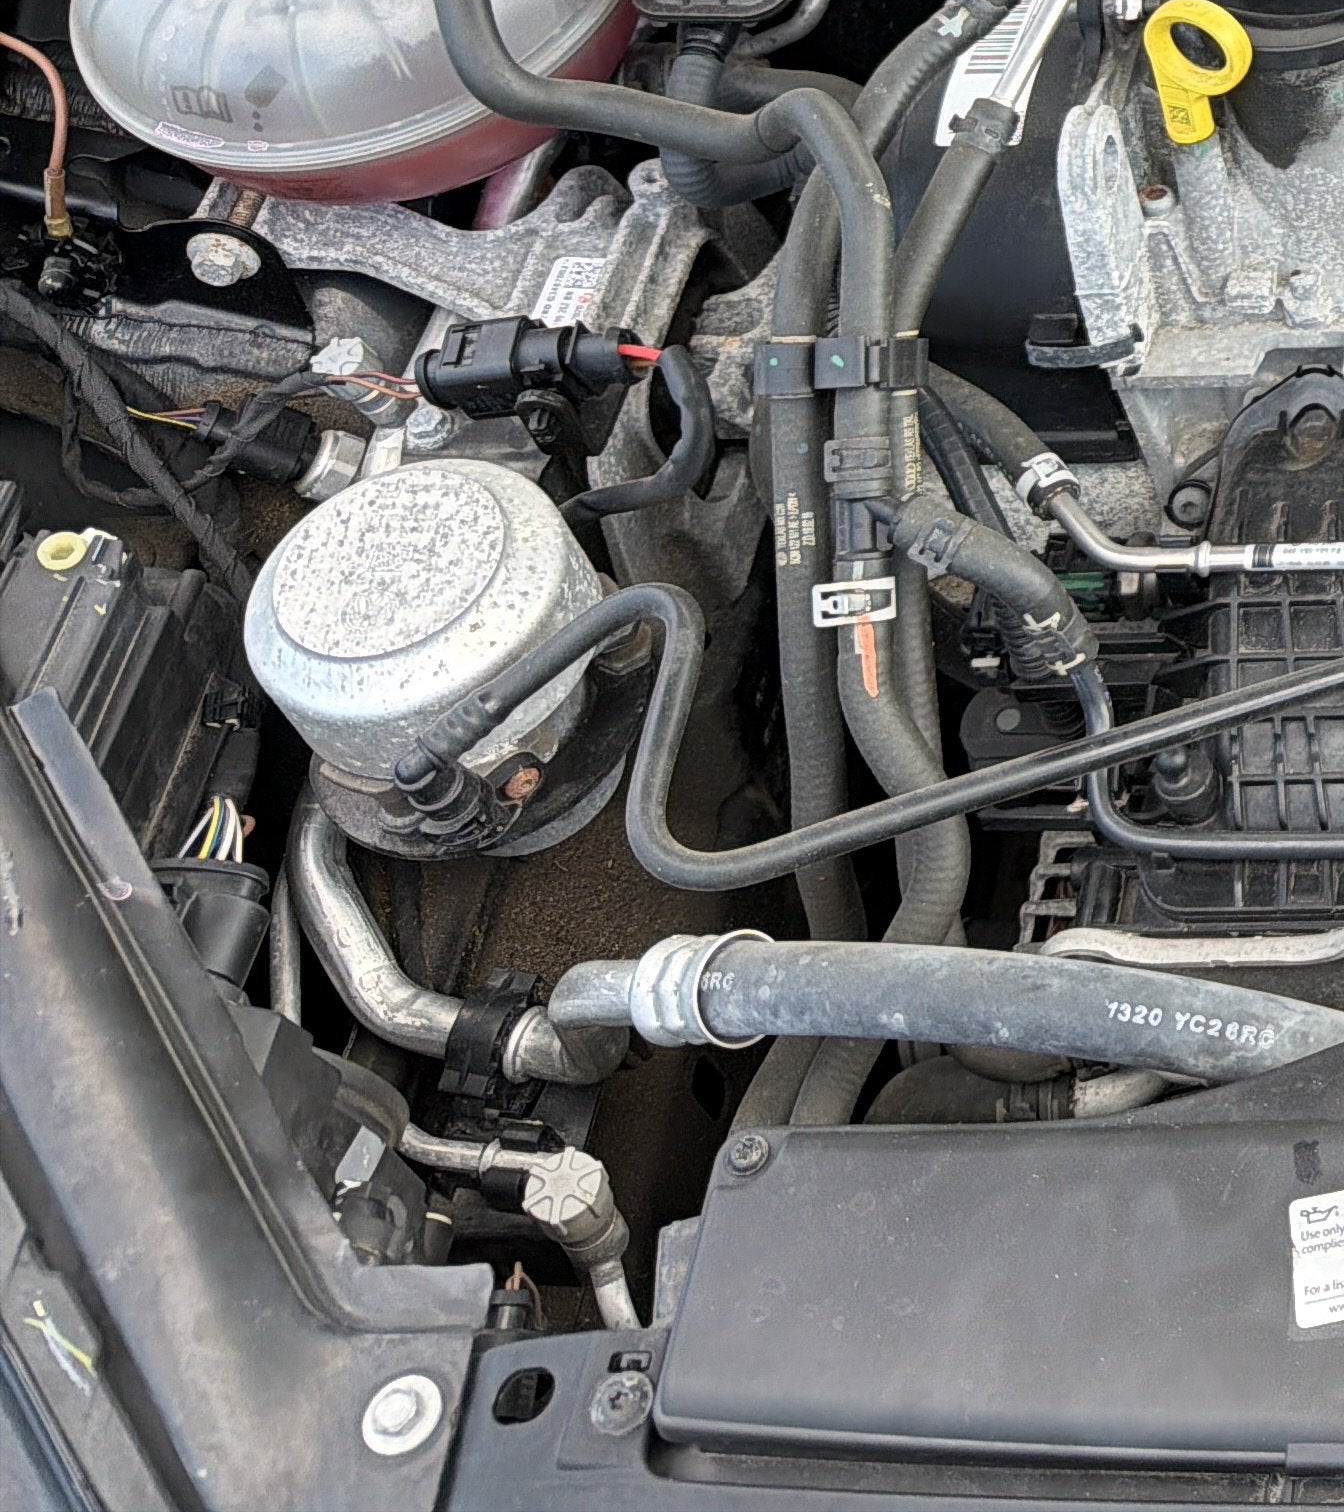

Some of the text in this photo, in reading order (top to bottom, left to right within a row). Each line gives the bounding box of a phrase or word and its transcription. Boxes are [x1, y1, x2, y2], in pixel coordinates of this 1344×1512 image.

[1300, 1229, 1320, 1241] Use
[1323, 1223, 1344, 1237] only
[1304, 1285, 1320, 1296] For
